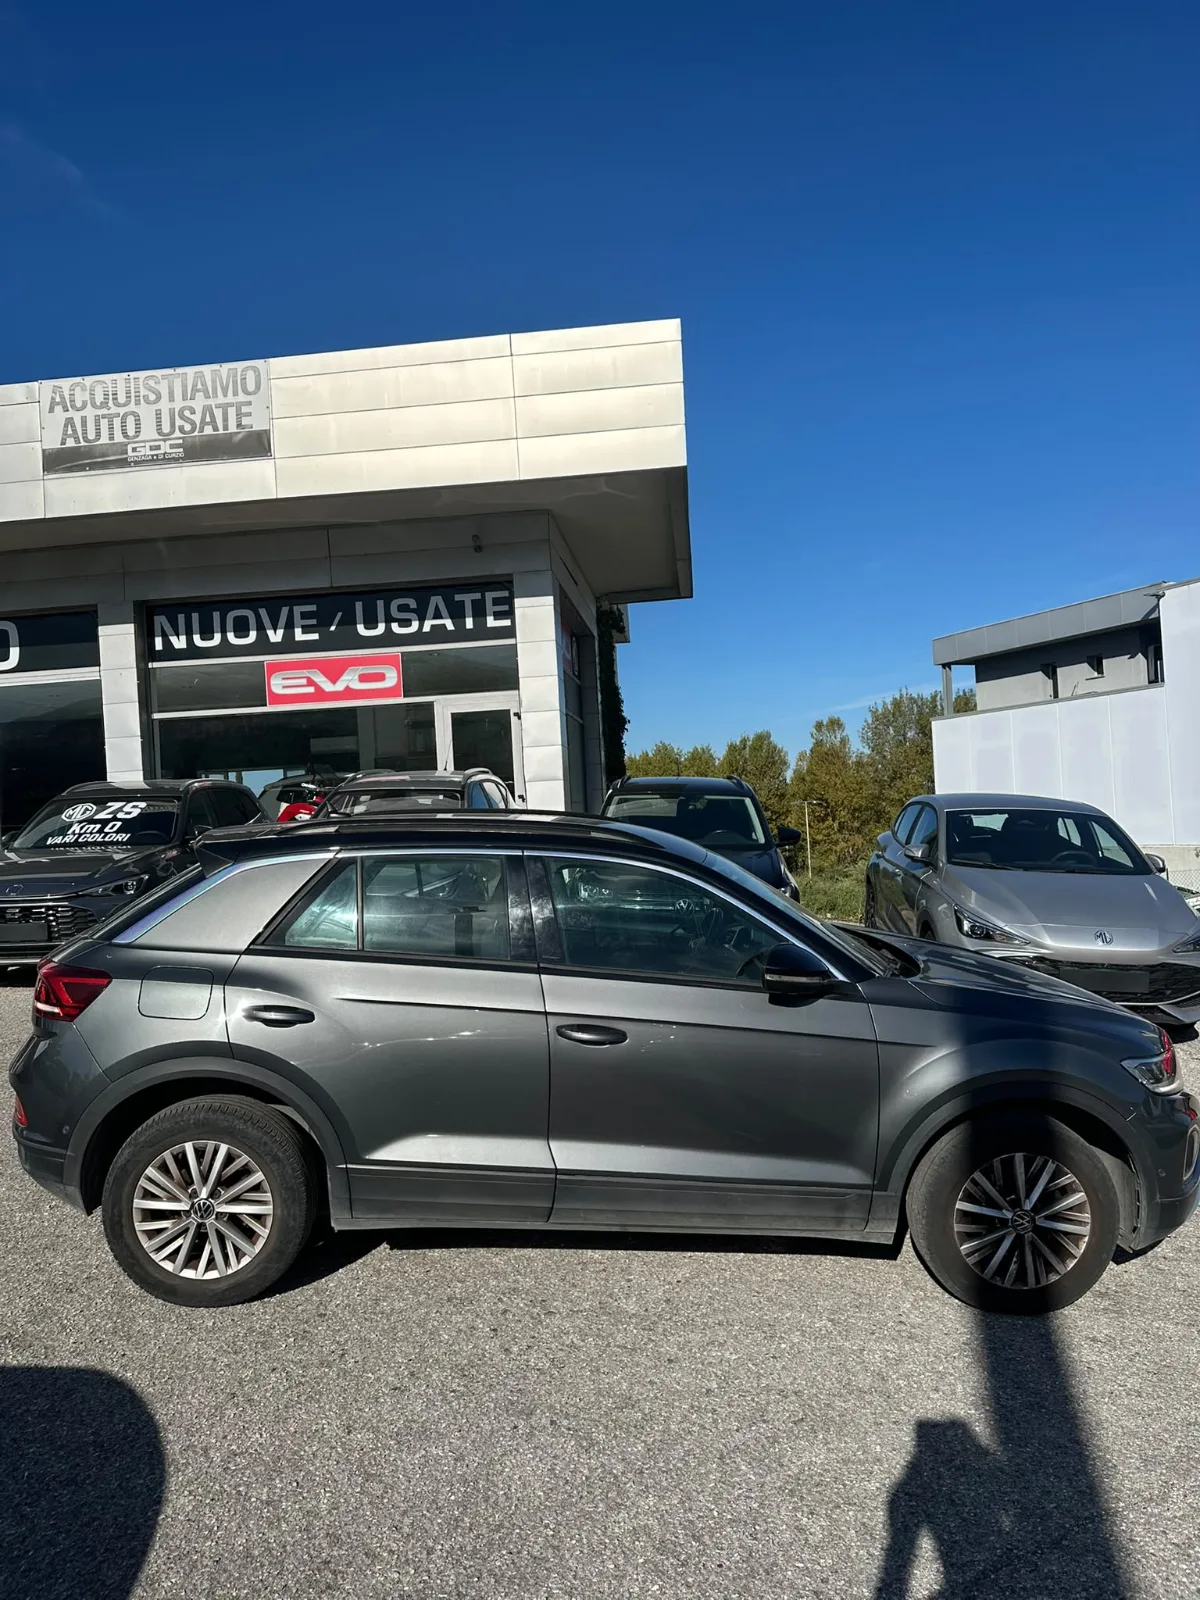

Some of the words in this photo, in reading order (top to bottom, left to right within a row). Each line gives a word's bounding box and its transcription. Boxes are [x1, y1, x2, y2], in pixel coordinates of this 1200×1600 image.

[48, 365, 262, 414] ACQUISTIAMO
[60, 410, 143, 446] AUTO
[155, 400, 254, 437] USATE
[128, 439, 184, 456] GDC
[154, 604, 319, 651] NUOVE
[355, 590, 511, 637] USATE
[269, 664, 399, 695] EVO
[93, 802, 147, 819] ZS
[46, 834, 77, 845] VARI
[78, 833, 131, 842] COLORI
[67, 822, 102, 834] Km
